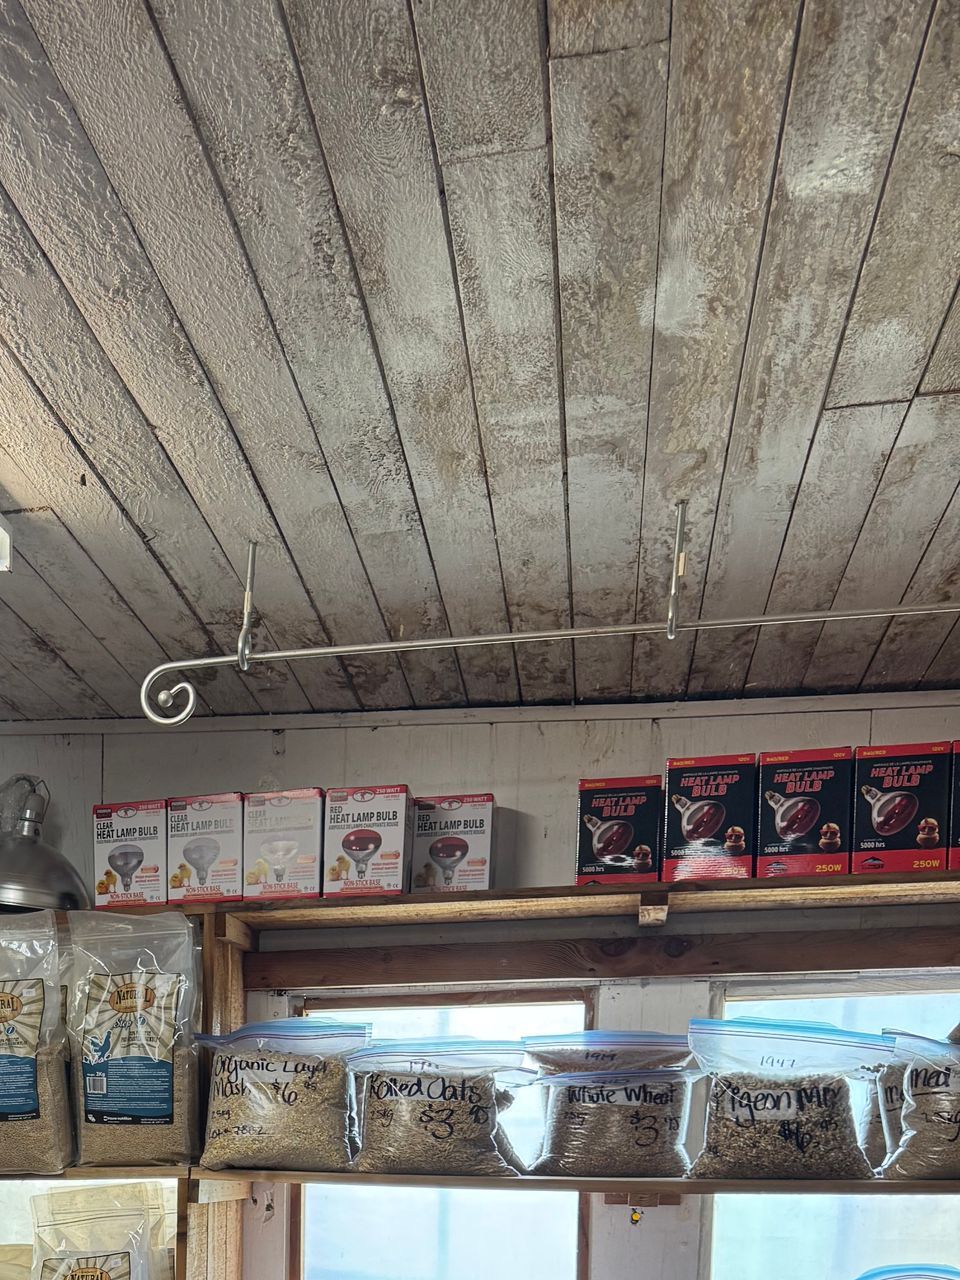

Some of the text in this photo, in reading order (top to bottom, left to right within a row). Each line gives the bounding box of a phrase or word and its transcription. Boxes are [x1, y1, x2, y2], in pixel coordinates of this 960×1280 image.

[774, 770, 835, 783] HEAT LAMP
[871, 764, 933, 778] HEAT LAMP
[680, 774, 740, 787] HEAT LAMP
[785, 780, 822, 793] BULB
[883, 775, 920, 788] BULB
[692, 785, 727, 797] BULB
[592, 796, 647, 807] HEAT LAMP
[330, 806, 343, 814] RED
[602, 805, 636, 816] BULB
[170, 815, 188, 823] CLEAR
[329, 811, 398, 824] HEAT LAMP BULB
[418, 814, 431, 822] RED
[96, 822, 113, 830] CLEAR
[170, 820, 212, 833] HEAT LAMP
[417, 819, 485, 832] HEAT LAMP BULB
[96, 829, 115, 840] HEAT
[116, 827, 137, 838] LAMP
[138, 825, 158, 836] BULB
[861, 841, 874, 849] 5000
[815, 864, 842, 872] 250W
[913, 860, 940, 868] 250W
[114, 1019, 132, 1031] Step
[215, 1054, 277, 1083] Organic
[214, 1077, 249, 1101] Mash
[370, 1073, 482, 1104] Rolled Oats
[624, 1083, 677, 1106] Wheat
